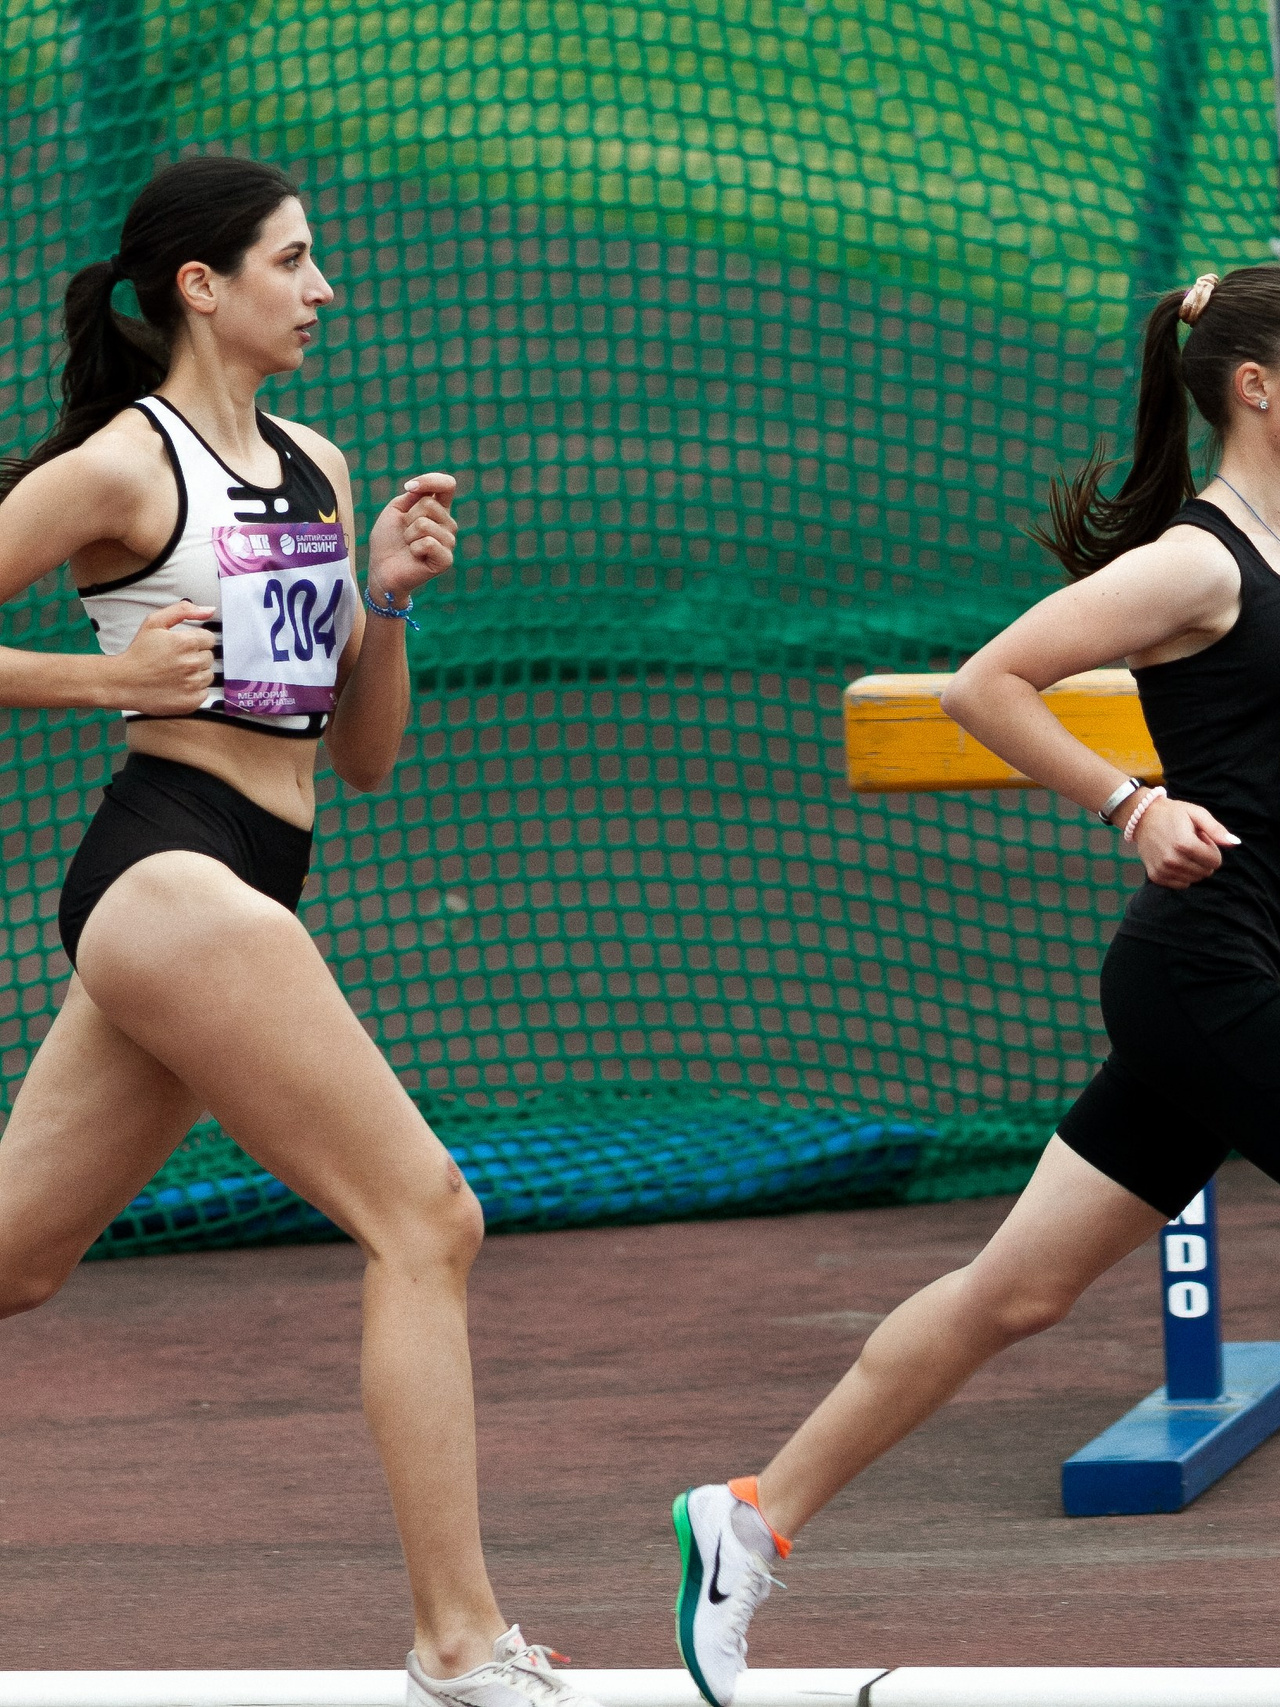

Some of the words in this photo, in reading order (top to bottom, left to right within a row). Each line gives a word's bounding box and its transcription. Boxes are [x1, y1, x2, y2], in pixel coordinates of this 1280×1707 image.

[296, 533, 338, 542] БАЛТИЙСКИЙ
[296, 542, 338, 554] ЛИЗИНГ
[263, 579, 344, 662] 204
